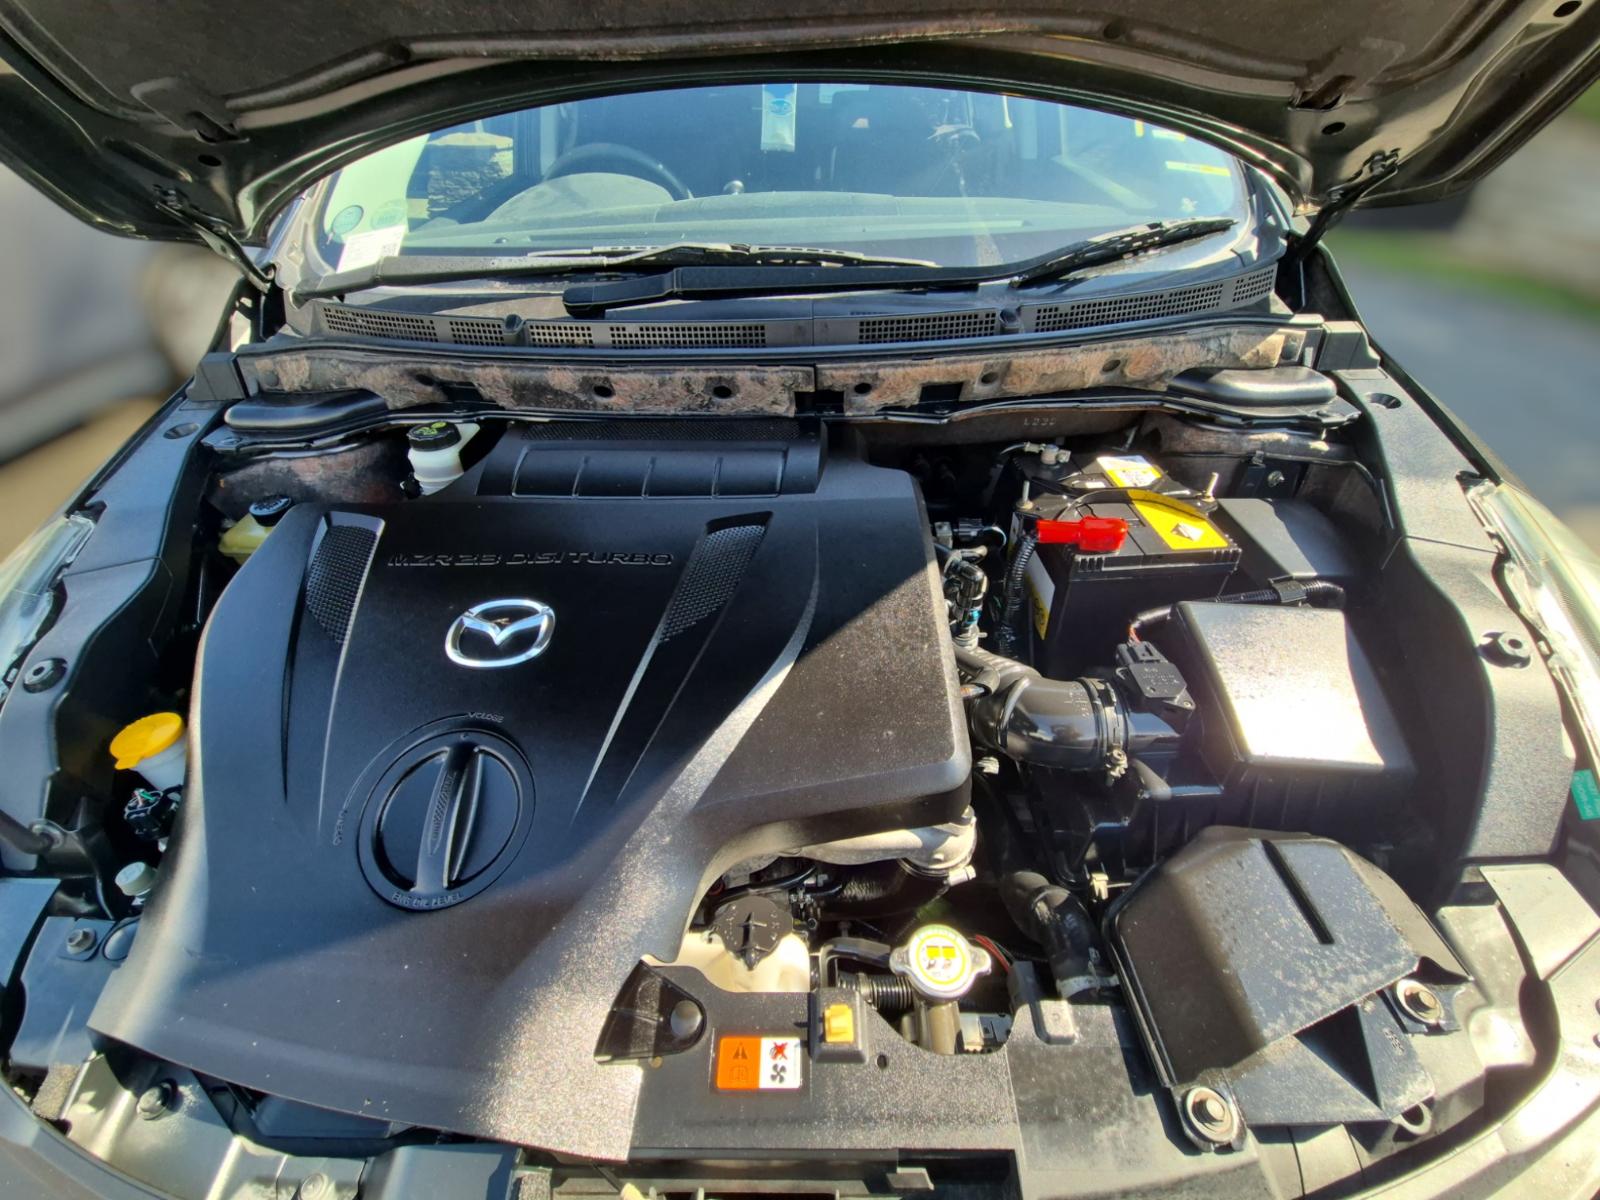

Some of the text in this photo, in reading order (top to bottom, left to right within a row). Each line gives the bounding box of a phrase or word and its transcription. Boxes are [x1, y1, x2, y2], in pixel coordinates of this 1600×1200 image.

[387, 553, 453, 566] MZR
[506, 552, 565, 565] DISI
[567, 552, 674, 566] TURBO
